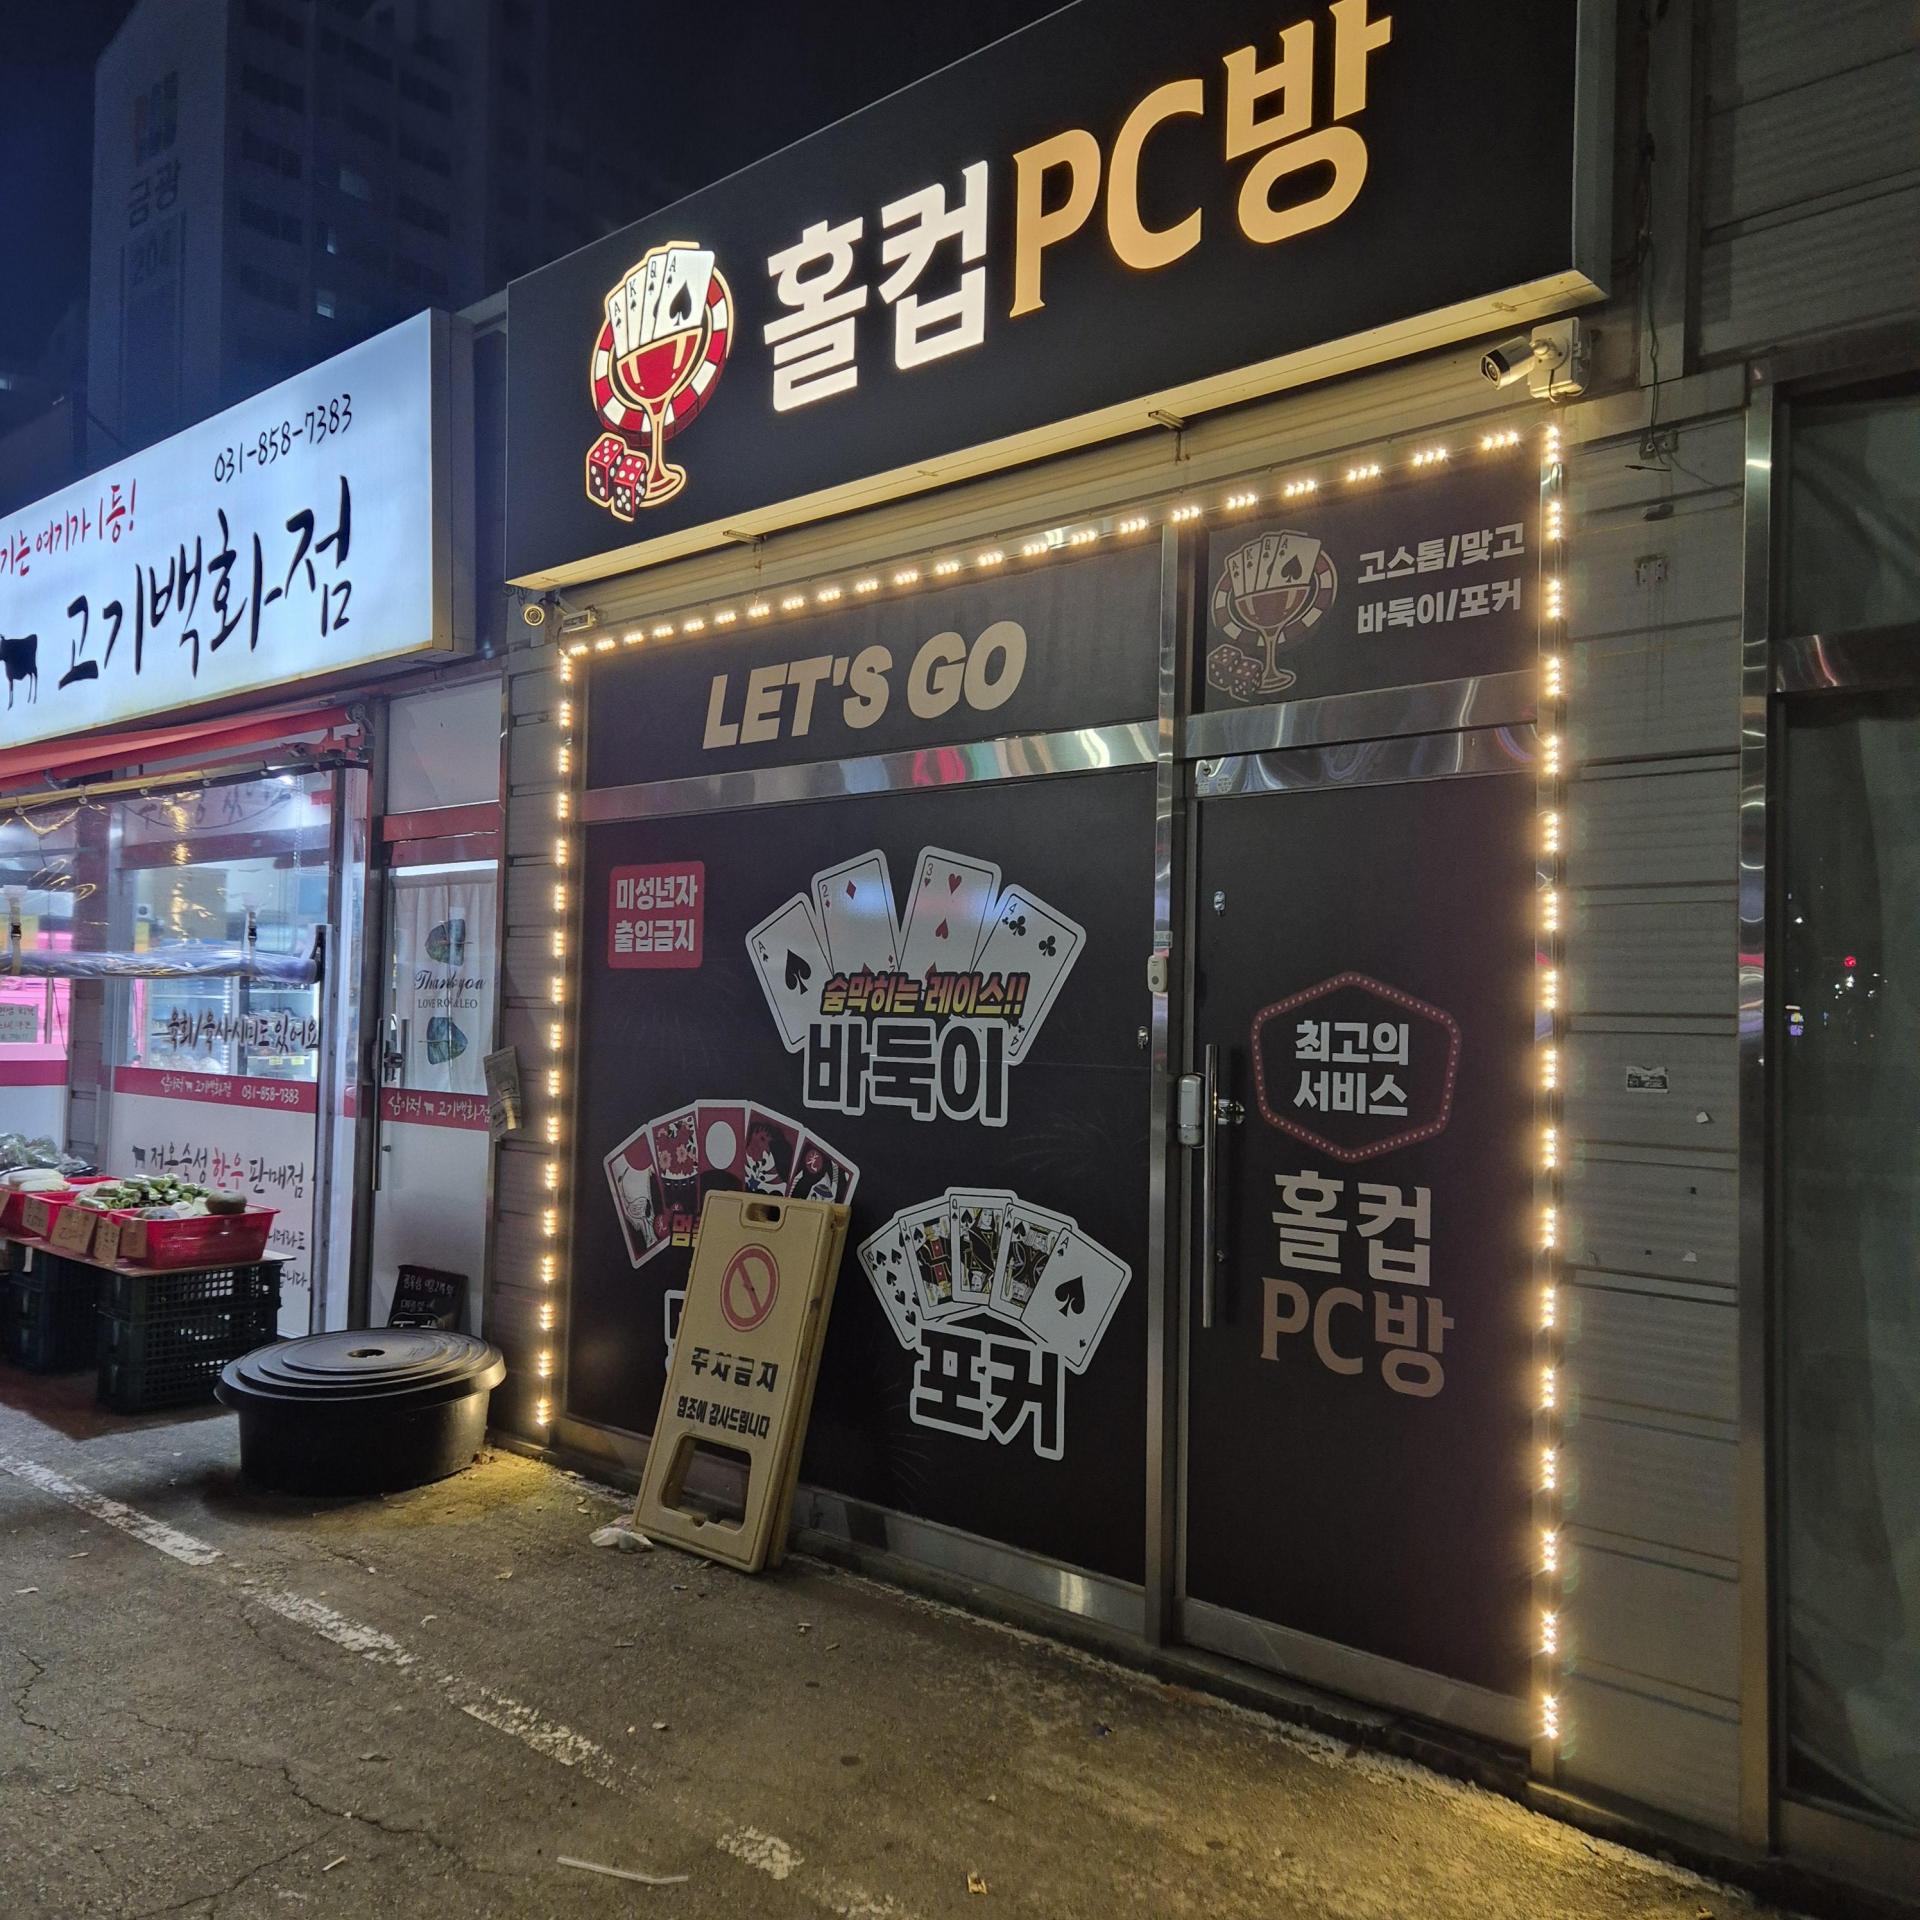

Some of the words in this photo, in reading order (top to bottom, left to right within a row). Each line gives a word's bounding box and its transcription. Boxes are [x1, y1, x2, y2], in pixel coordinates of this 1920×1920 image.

[214, 394, 352, 484] 031-858-7383
[36, 507, 91, 555] 여기가
[1358, 522, 1525, 584] 고스톱/맞고
[58, 475, 352, 690] 고기백화점
[1357, 577, 1522, 634] 바둑이/포커
[703, 645, 893, 749] LET'S
[907, 620, 1027, 720] GO
[616, 875, 698, 911] 미성년자
[614, 918, 695, 953] 출입금지
[822, 972, 922, 1015] 숨막히는
[924, 972, 1030, 1015] 레이스!!
[1295, 1020, 1409, 1066] 최고의
[241, 1084, 300, 1104] 031-858-7383
[804, 1017, 1007, 1126] 바둑이
[1293, 1070, 1408, 1117] 서비스
[212, 1147, 244, 1190] 한우
[249, 1157, 304, 1199] 판매점
[1272, 1170, 1431, 1287] 홀컵
[1260, 1276, 1455, 1398] PC방
[691, 1346, 779, 1393] 주차금지
[910, 1328, 1064, 1461] 포커
[709, 1403, 771, 1440] 감사드립니다
